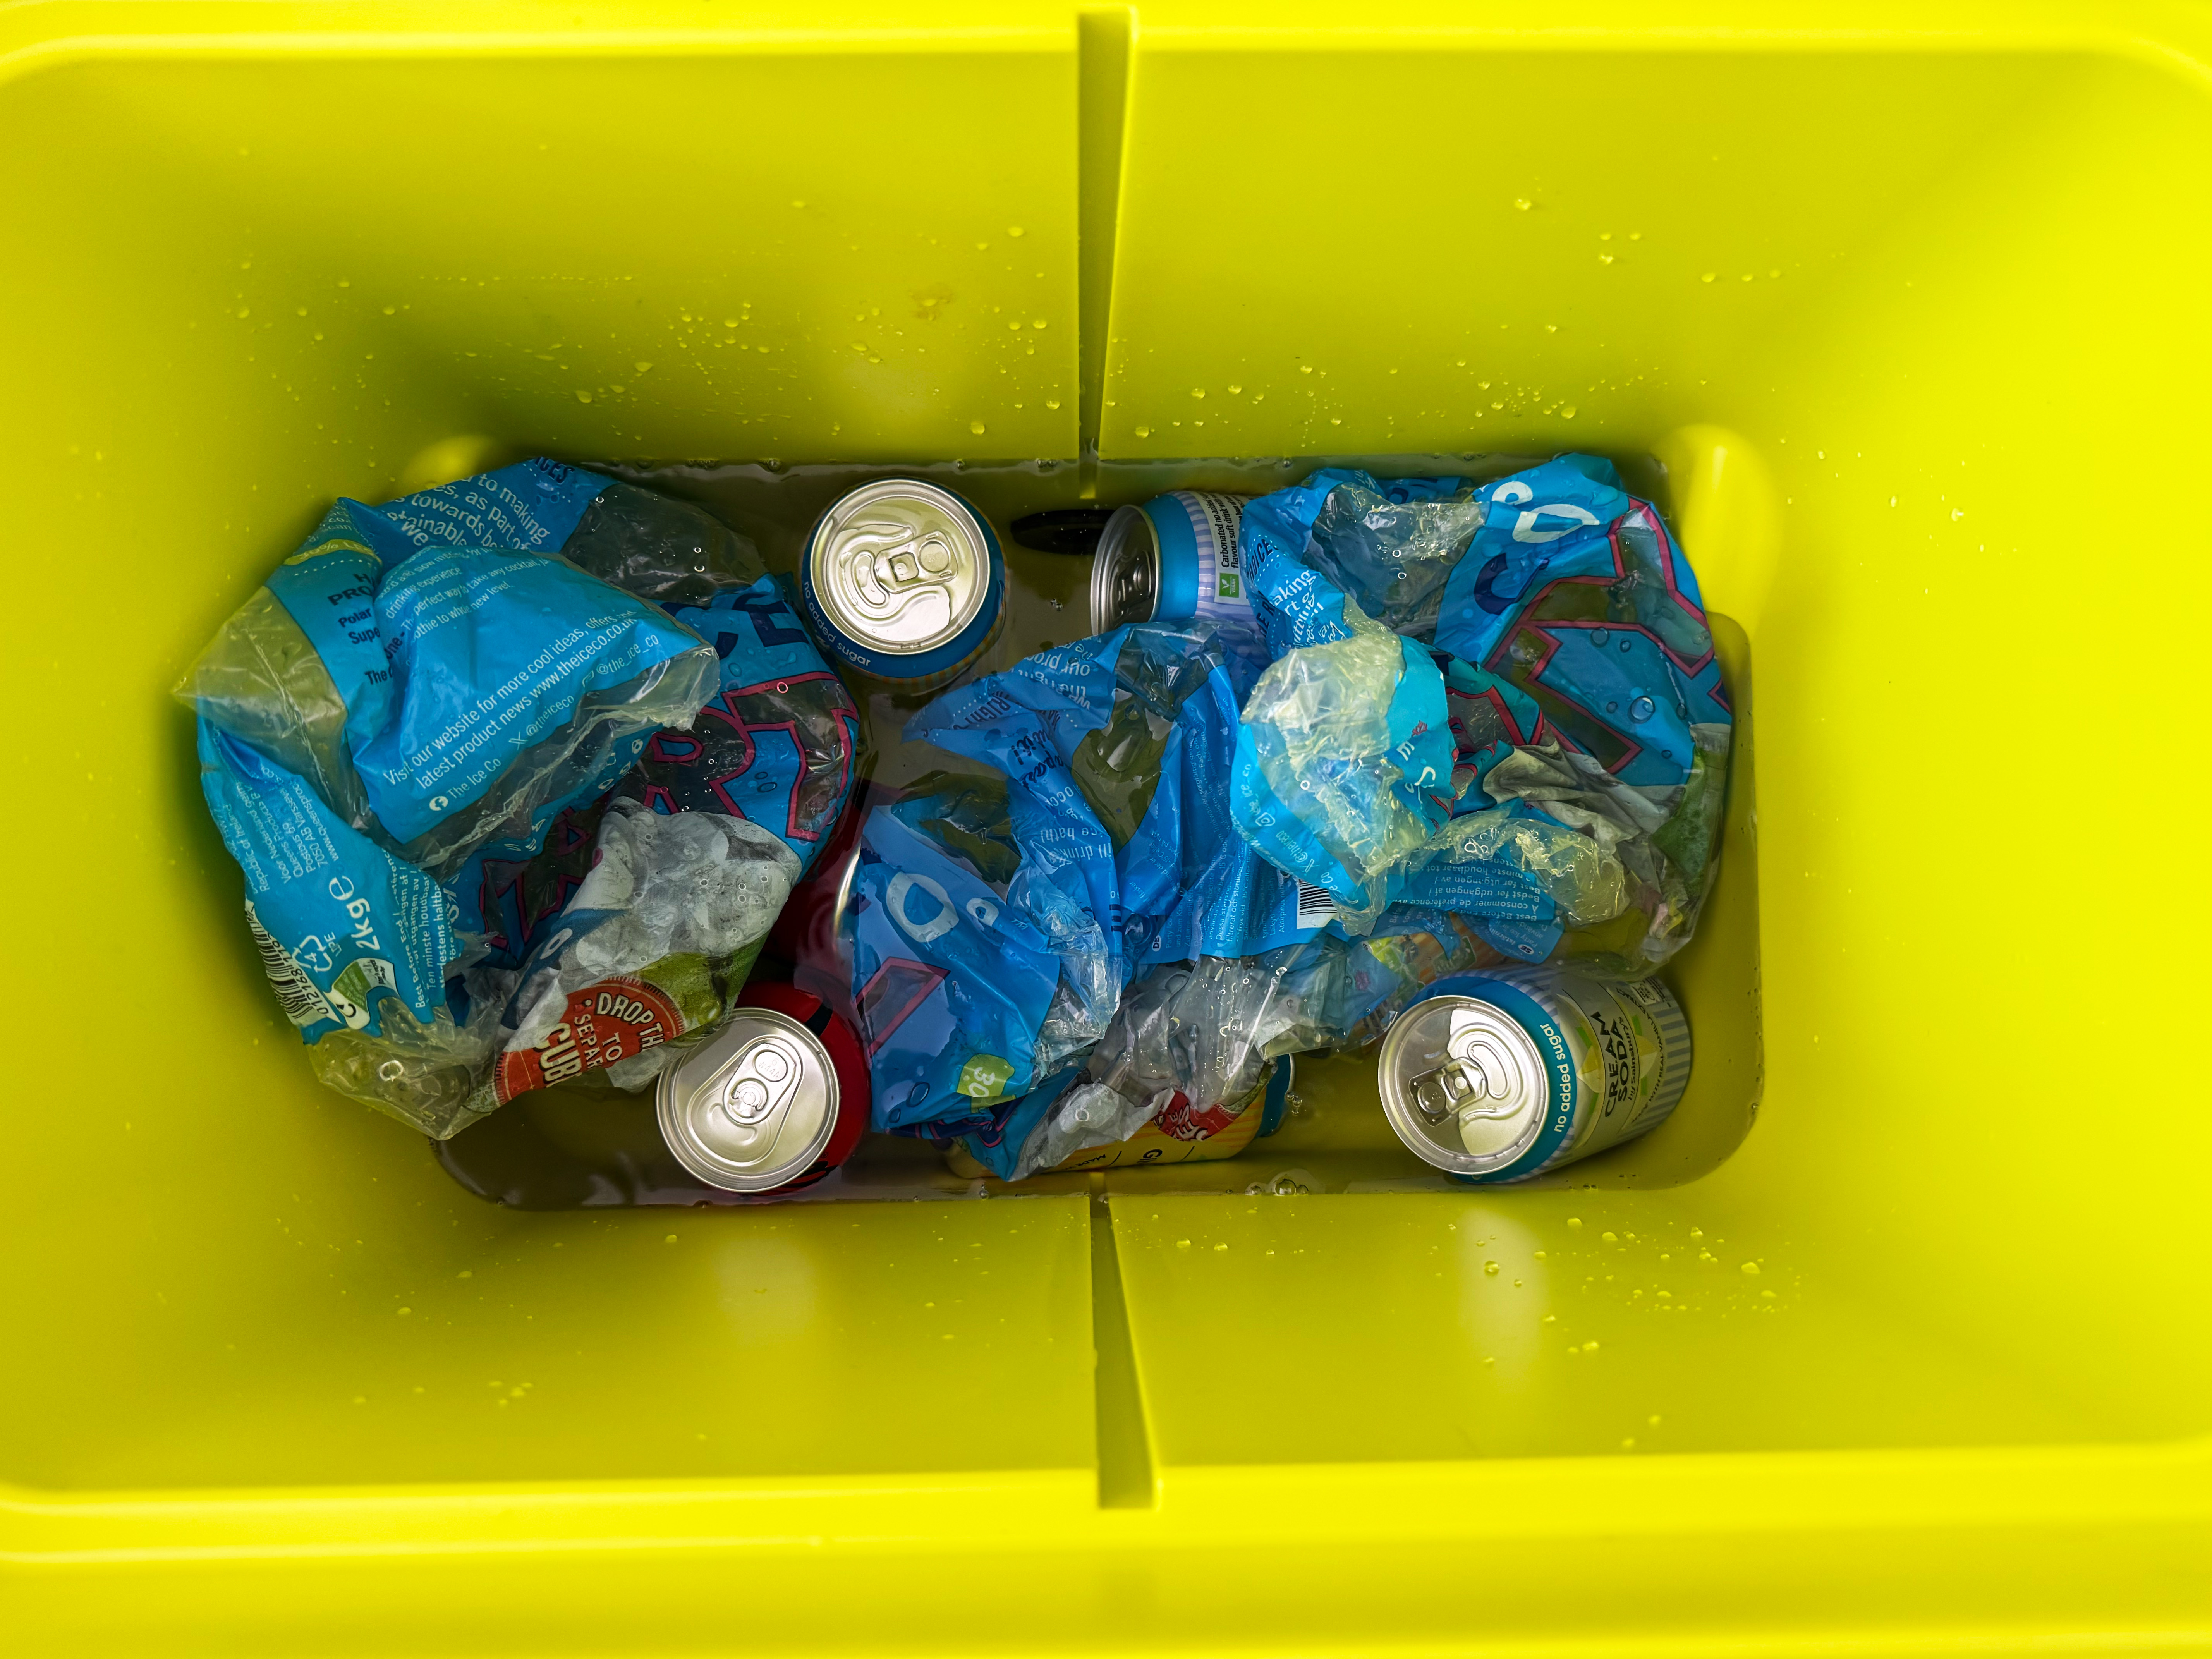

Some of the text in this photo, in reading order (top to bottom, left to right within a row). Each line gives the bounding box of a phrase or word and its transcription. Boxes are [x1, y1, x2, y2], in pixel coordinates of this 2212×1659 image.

[411, 493, 486, 537] towards
[465, 491, 489, 510] as
[489, 505, 516, 542] part
[478, 473, 551, 545] to making
[1214, 515, 1223, 524] no
[1223, 509, 1233, 524] drink
[1216, 524, 1230, 568] Carbonated
[1226, 524, 1235, 539] soft
[1231, 541, 1239, 569] flavour
[385, 567, 463, 620] drinking experience
[413, 591, 447, 616] perfect
[467, 574, 489, 590] take
[490, 568, 507, 578] any
[505, 559, 541, 572] cocktail,
[1272, 570, 1317, 606] aking
[338, 607, 372, 628] Polar
[412, 618, 439, 644] othie
[436, 613, 450, 624] to
[470, 592, 490, 610] new
[804, 581, 871, 667] no added sugar
[348, 627, 380, 645] Supe
[594, 632, 660, 676] @the_ice_co
[364, 670, 387, 685] The
[1060, 663, 1091, 677] our
[383, 757, 415, 787] Visit
[412, 744, 433, 768] our
[431, 709, 482, 750] website
[475, 692, 500, 717] for
[497, 670, 531, 700] more
[527, 644, 555, 674] cool
[549, 626, 591, 657] ideas,
[584, 614, 618, 630] offers
[524, 694, 576, 737] @theiceco
[414, 758, 456, 790] latest
[454, 720, 504, 765] product
[497, 694, 533, 728] news
[445, 757, 503, 801] The Ice Co
[280, 840, 304, 878] Queens
[300, 826, 329, 868] 7050 AB
[244, 848, 271, 892] Republic
[276, 858, 292, 885] Voor
[1474, 900, 1528, 909] consommer
[1511, 892, 1540, 903] Bedst
[346, 898, 380, 951] 2kg
[1216, 917, 1225, 941] Dessa
[1226, 916, 1236, 942] filtrerat
[1516, 913, 1538, 922] Best
[1152, 936, 1160, 949] DE
[1165, 929, 1174, 948] Party
[1520, 944, 1533, 954] SE
[414, 984, 426, 1008] Best
[426, 971, 437, 990] Ten
[594, 992, 665, 1053] DROP TH
[534, 1022, 582, 1088] CUB
[601, 1032, 623, 1062] TO
[1590, 1010, 1620, 1118] CREAM
[1609, 1018, 1630, 1102] SODA
[1539, 1023, 1571, 1132] no added sugar
[1627, 1085, 1636, 1101] by
[1649, 1078, 1661, 1103] WITH
